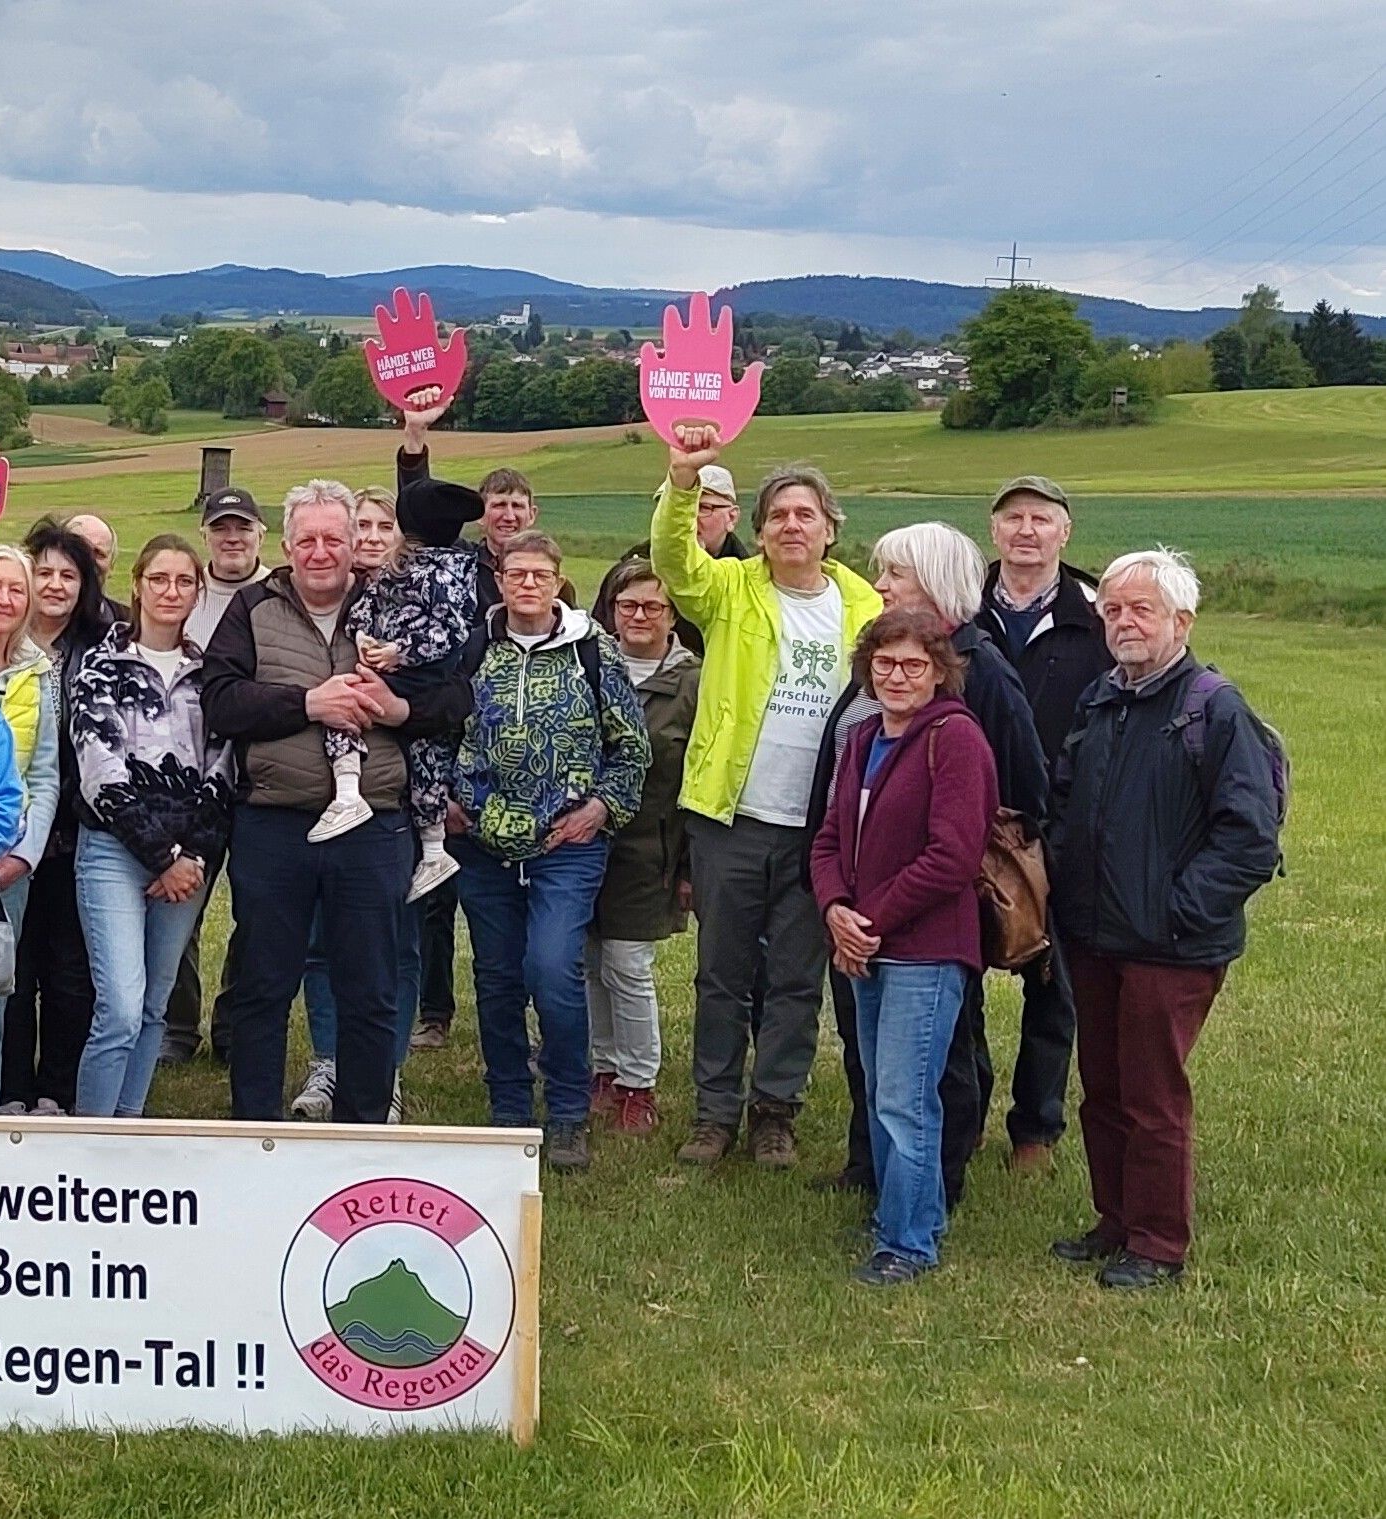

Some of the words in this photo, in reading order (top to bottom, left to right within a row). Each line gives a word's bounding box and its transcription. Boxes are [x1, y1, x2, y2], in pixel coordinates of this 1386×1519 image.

[377, 353, 410, 372] HÄNDE
[411, 347, 435, 363] WEG
[379, 369, 395, 380] VON
[395, 366, 410, 378] DER
[411, 360, 436, 373] NATUR!
[649, 367, 691, 388] HÄNDE
[694, 372, 722, 389] WEG
[648, 387, 666, 399] VON
[668, 388, 686, 400] DER
[688, 389, 721, 401] NATUR!
[772, 687, 832, 705] urschutz
[808, 707, 829, 720] e.V.
[340, 1190, 450, 1226] Rettet
[91, 1250, 147, 1300] im
[237, 1342, 265, 1390] !!
[310, 1339, 353, 1382] das
[361, 1340, 487, 1406] Regental
